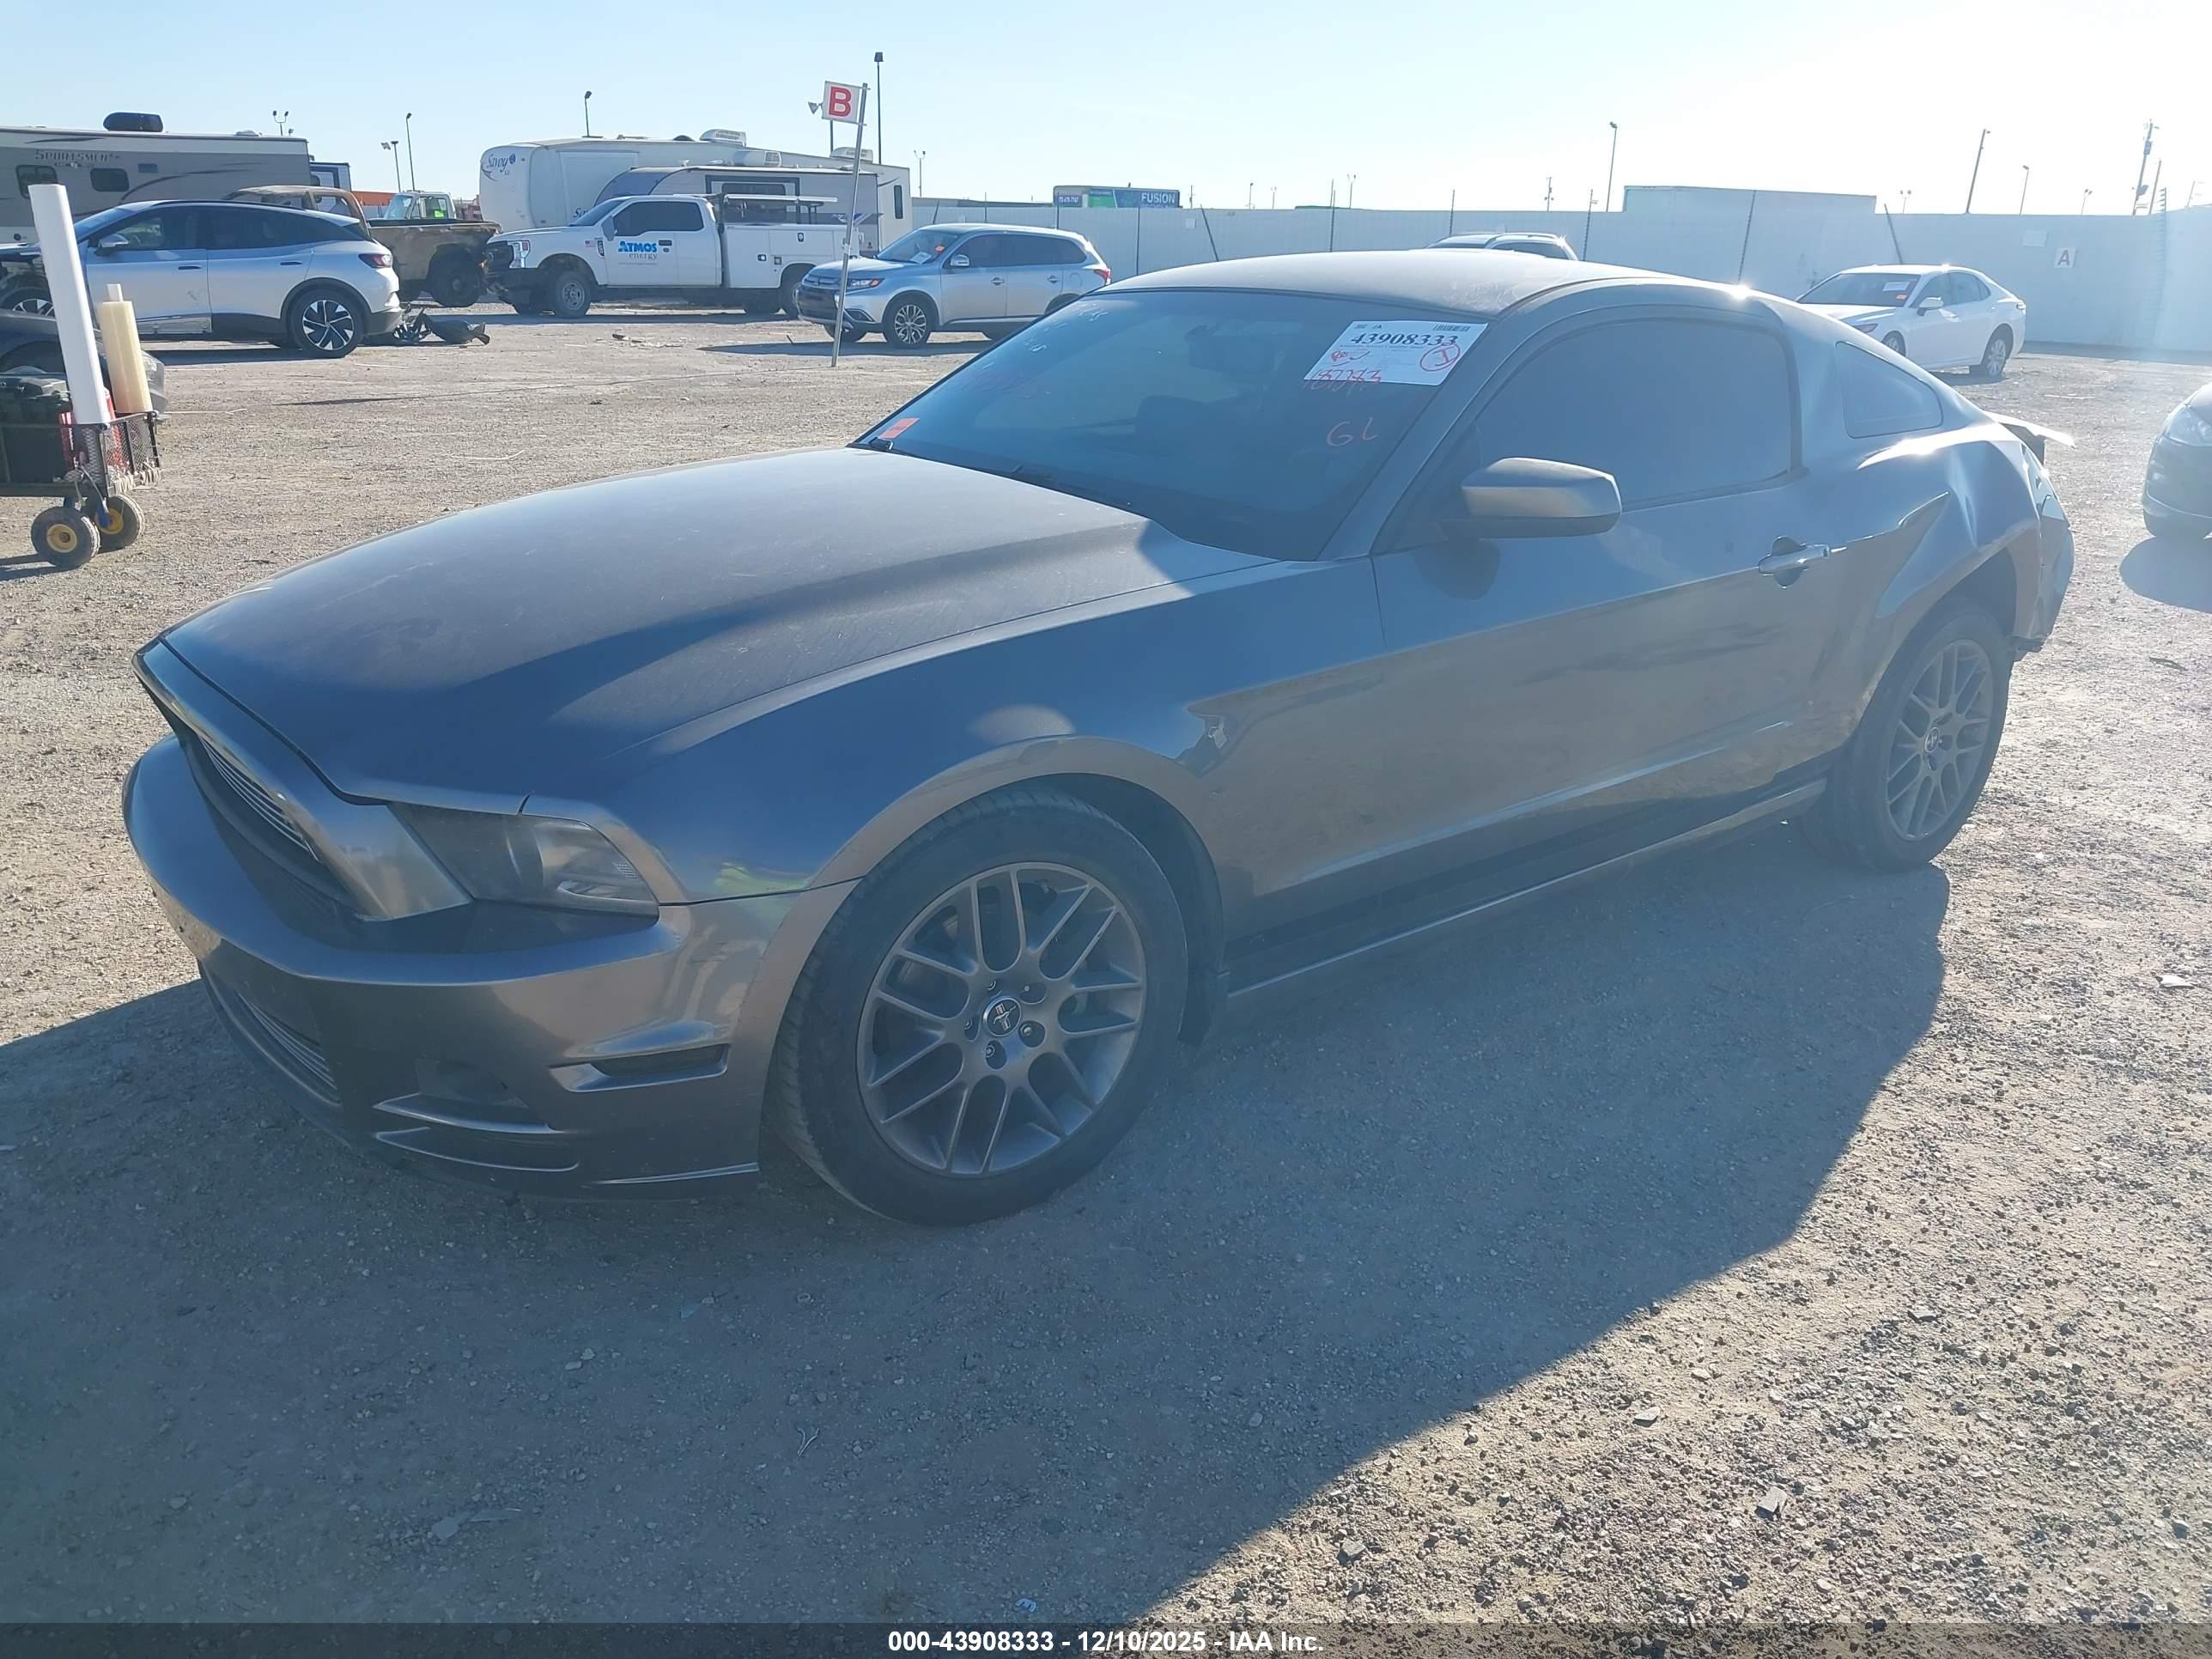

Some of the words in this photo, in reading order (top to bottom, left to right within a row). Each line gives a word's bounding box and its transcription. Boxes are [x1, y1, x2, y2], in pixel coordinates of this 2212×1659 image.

[829, 86, 852, 117] B
[1141, 191, 1176, 204] FUSION
[618, 241, 658, 252] ATMOS
[2057, 249, 2070, 266] A
[1351, 332, 1459, 346] 43908333
